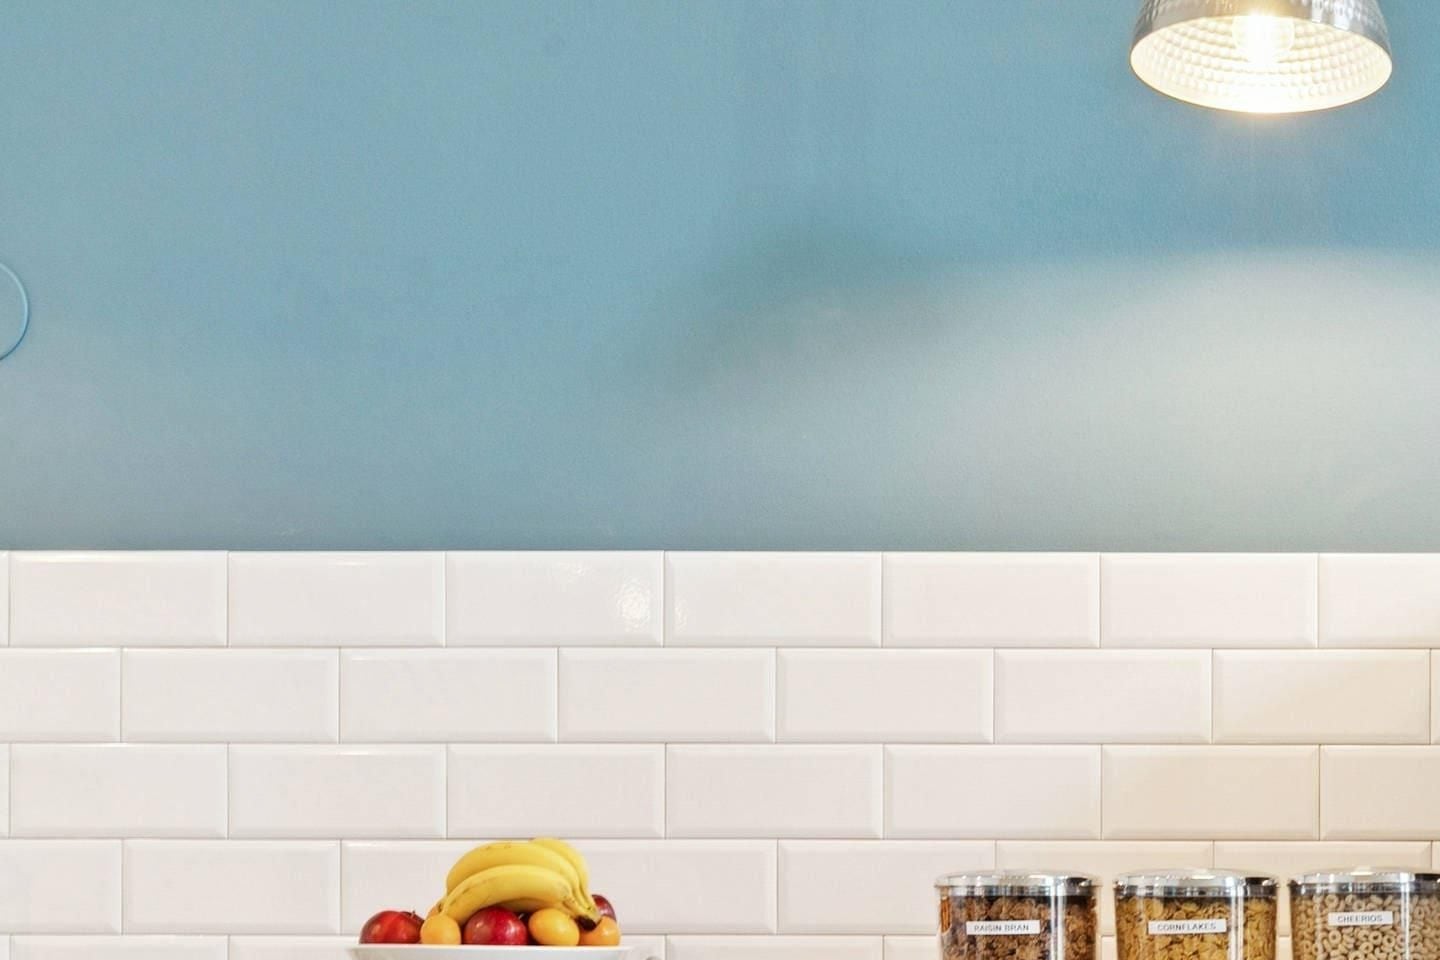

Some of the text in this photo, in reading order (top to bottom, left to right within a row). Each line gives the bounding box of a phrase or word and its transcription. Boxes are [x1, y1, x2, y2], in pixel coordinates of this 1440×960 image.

[1337, 914, 1383, 923] CHEERIOS
[974, 923, 1030, 932] RAISIN BRAN
[1157, 923, 1217, 932] CORNFLAKES
